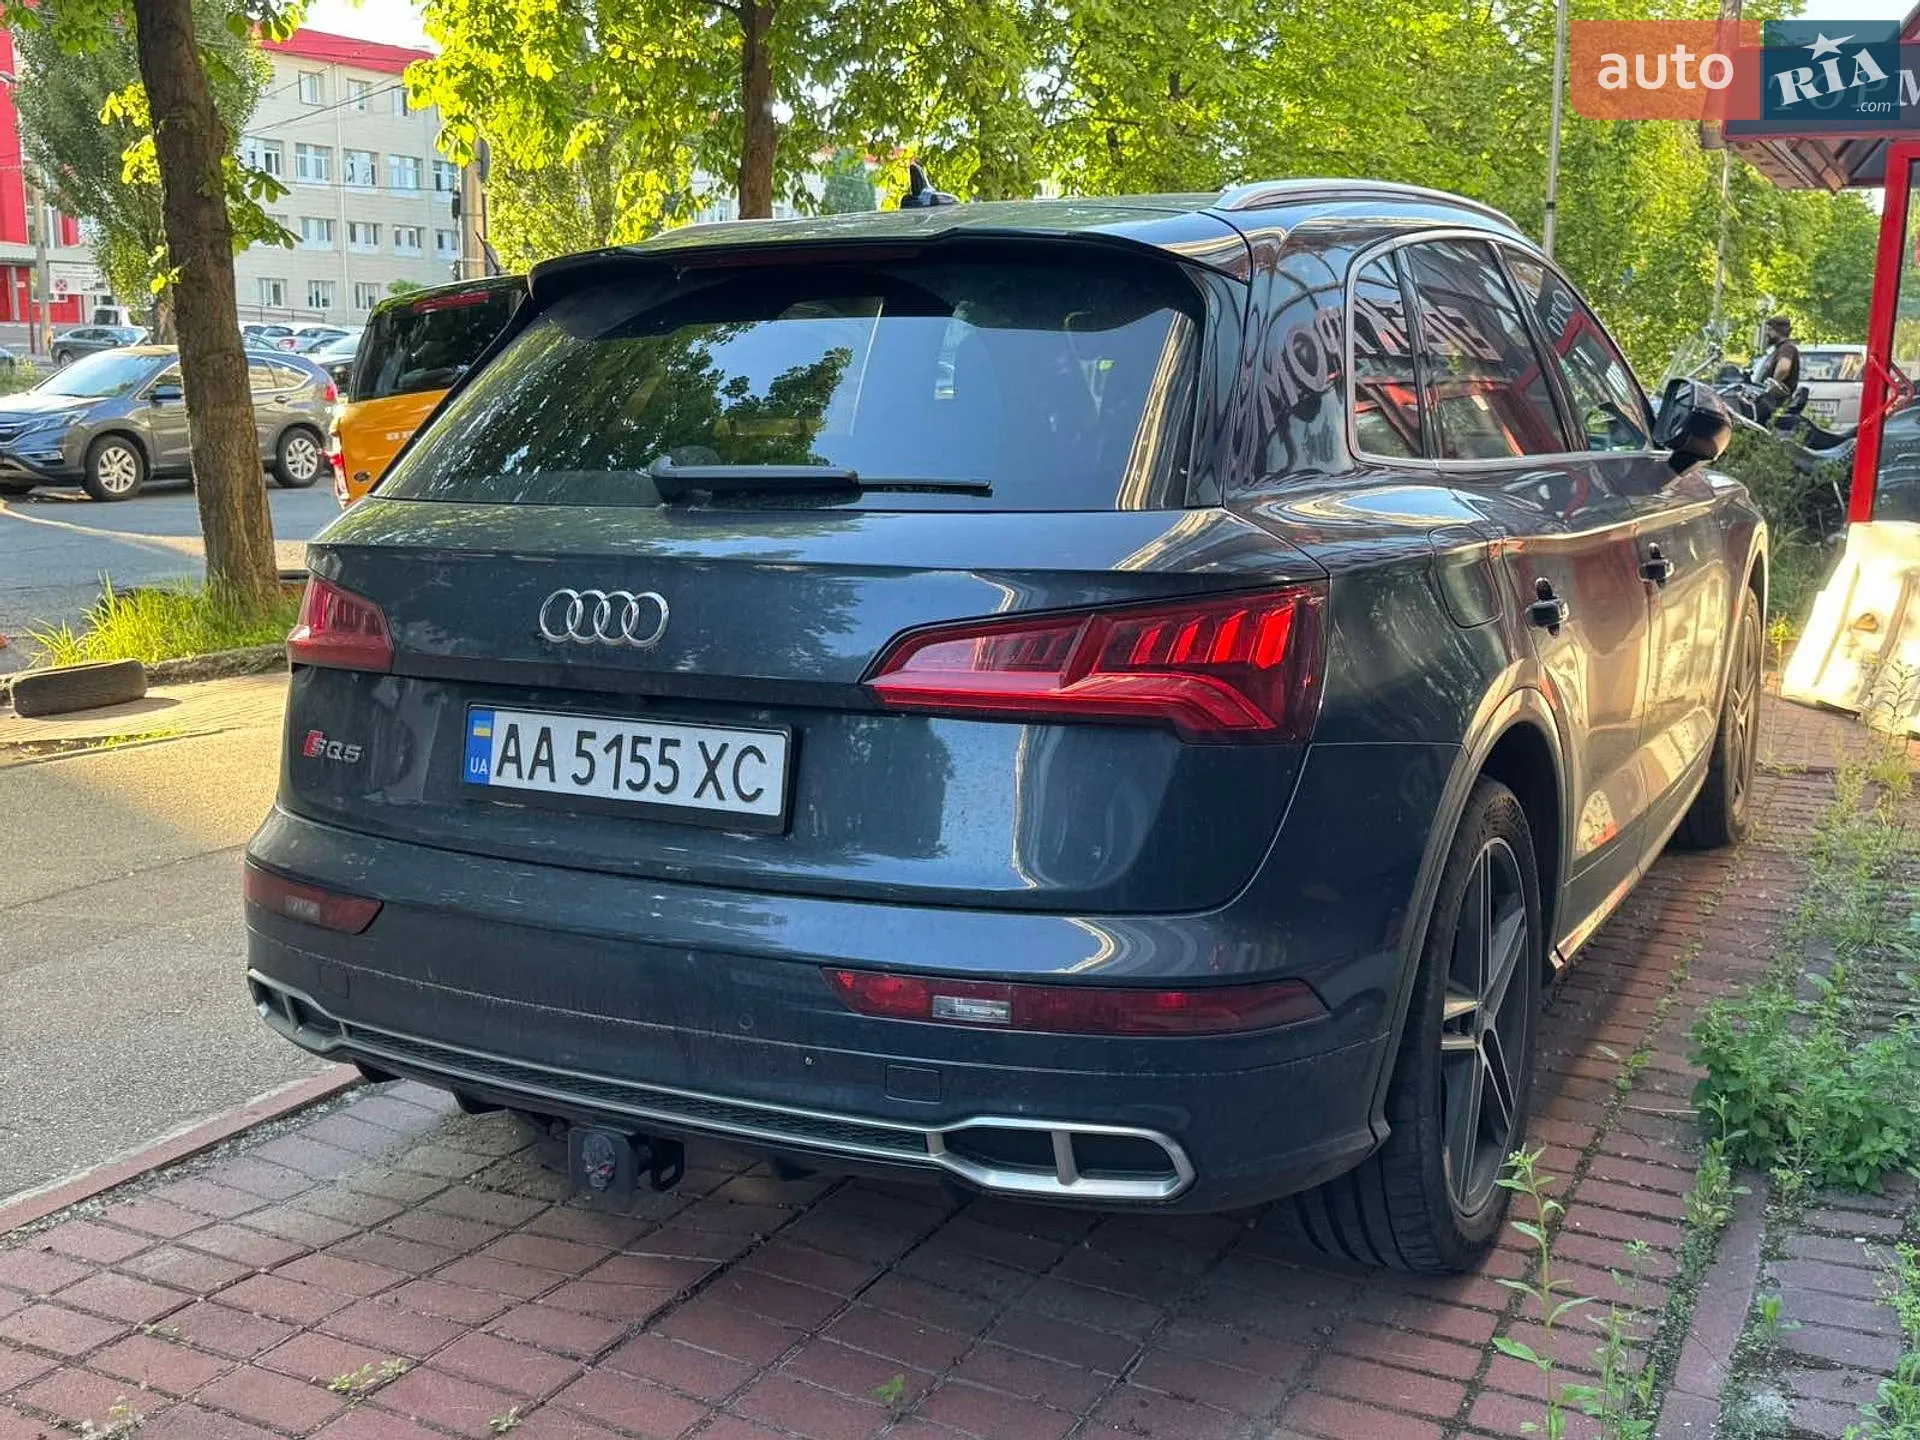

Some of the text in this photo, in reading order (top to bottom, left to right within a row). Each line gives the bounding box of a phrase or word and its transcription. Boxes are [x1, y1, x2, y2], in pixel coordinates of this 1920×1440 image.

[303, 729, 362, 763] SQ5
[496, 723, 767, 803] AA 5155 XC
[470, 756, 489, 775] UA
